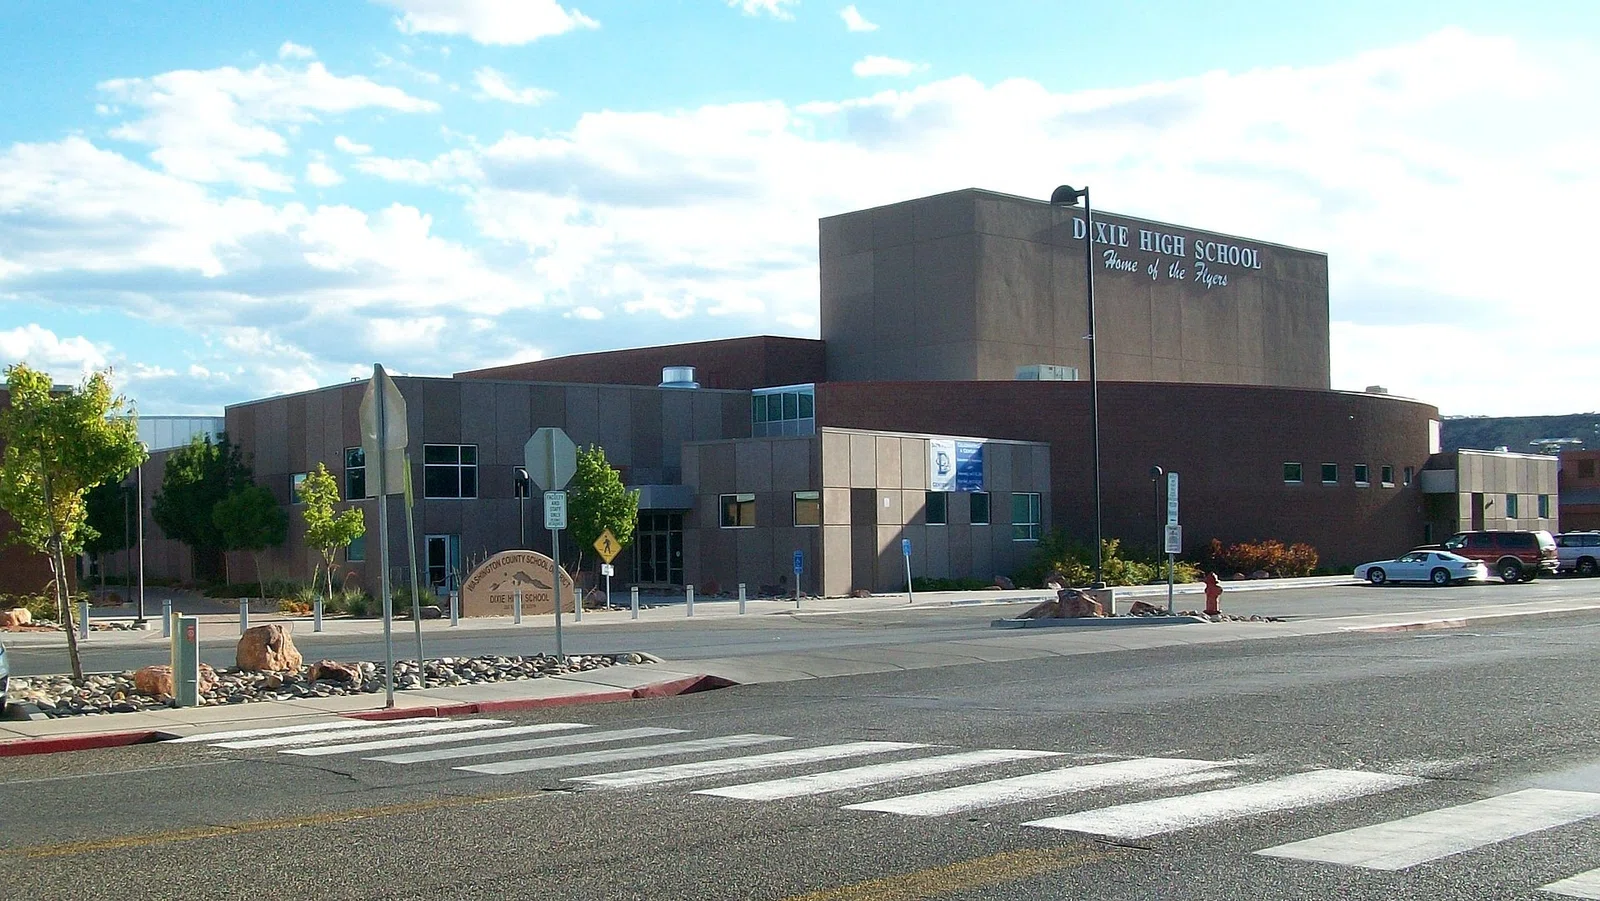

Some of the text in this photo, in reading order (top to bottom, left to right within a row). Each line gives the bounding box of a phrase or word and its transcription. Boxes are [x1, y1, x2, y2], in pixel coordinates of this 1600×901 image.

[1103, 249, 1228, 289] Home of the Flyers
[1140, 229, 1186, 257] HIGH
[1195, 239, 1262, 270] SCHOOL
[467, 560, 502, 592] WASHINGTON
[502, 554, 525, 568] COUNTY
[526, 555, 548, 570] SCHOOL
[525, 593, 550, 602] SCHOOL
